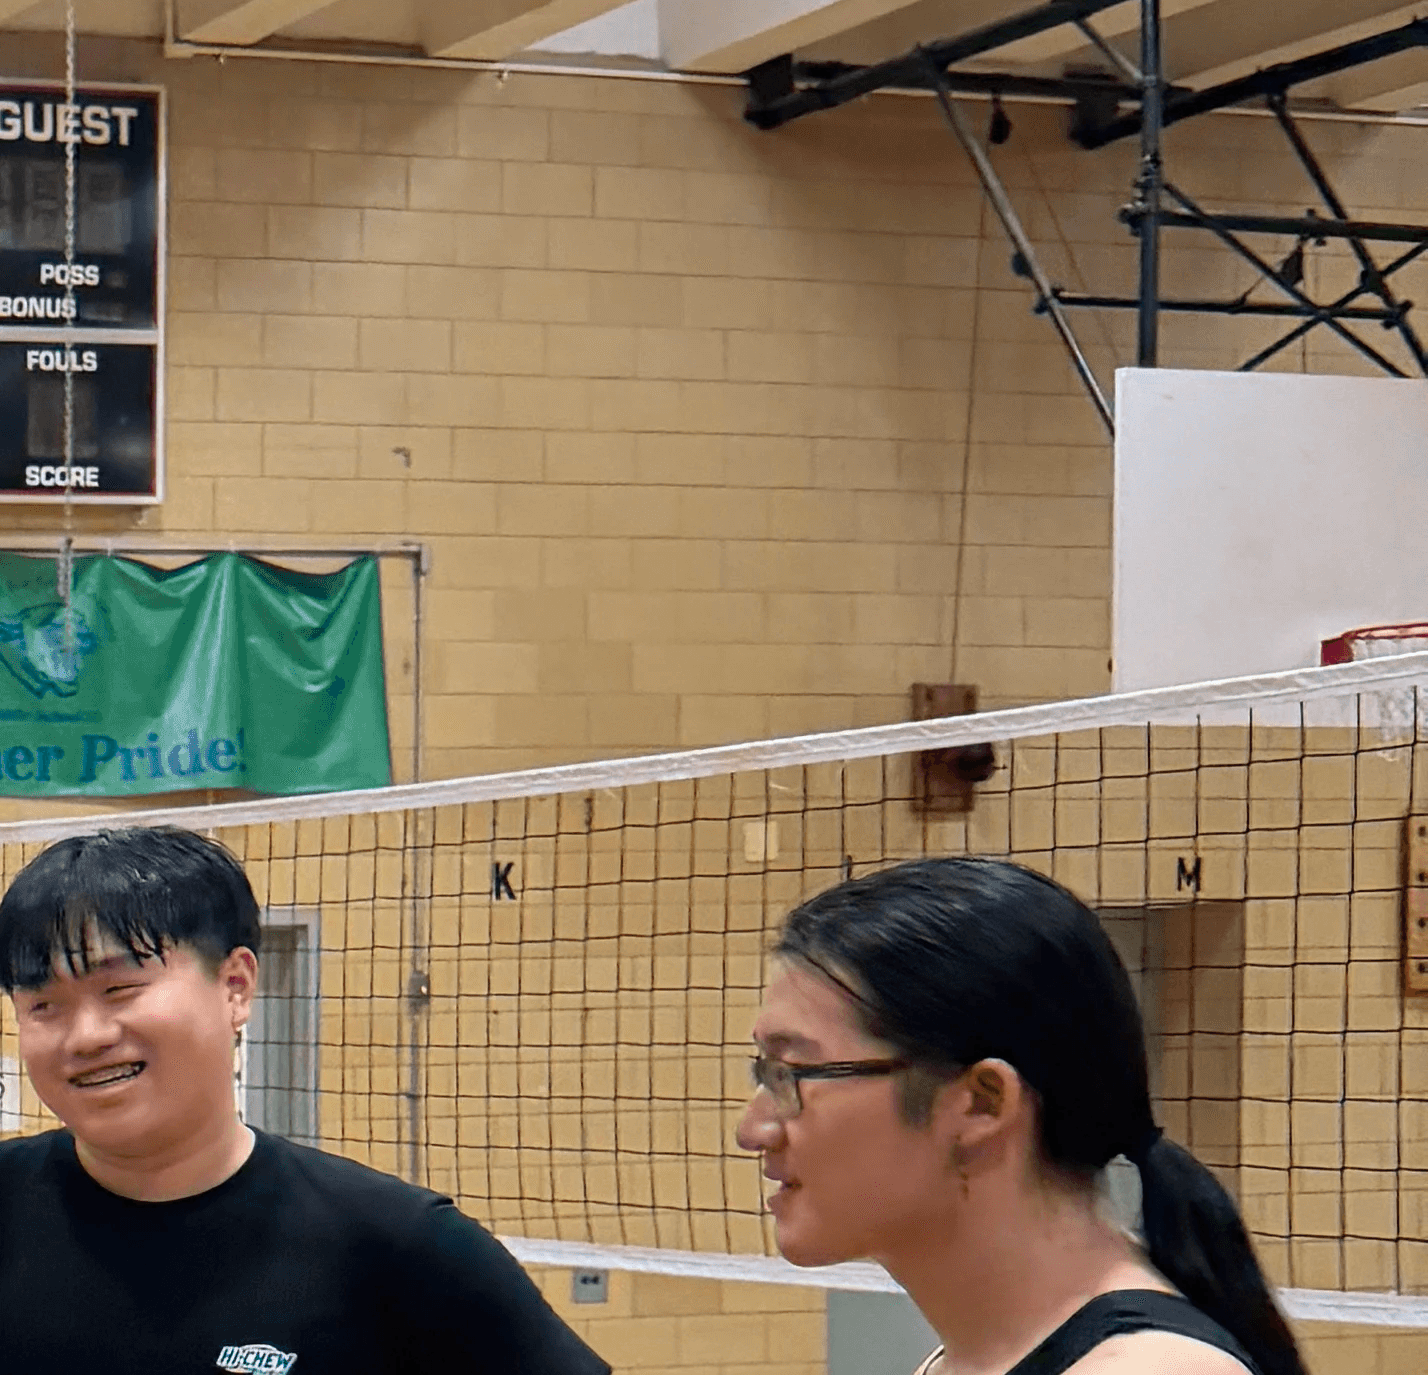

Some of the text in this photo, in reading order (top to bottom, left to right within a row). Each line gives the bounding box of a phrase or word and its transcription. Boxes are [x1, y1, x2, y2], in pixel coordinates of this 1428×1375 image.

[40, 263, 100, 286] POSS
[27, 350, 98, 372] FOULS
[25, 465, 100, 487] SCORE
[494, 862, 517, 901] K
[1177, 856, 1202, 892] M
